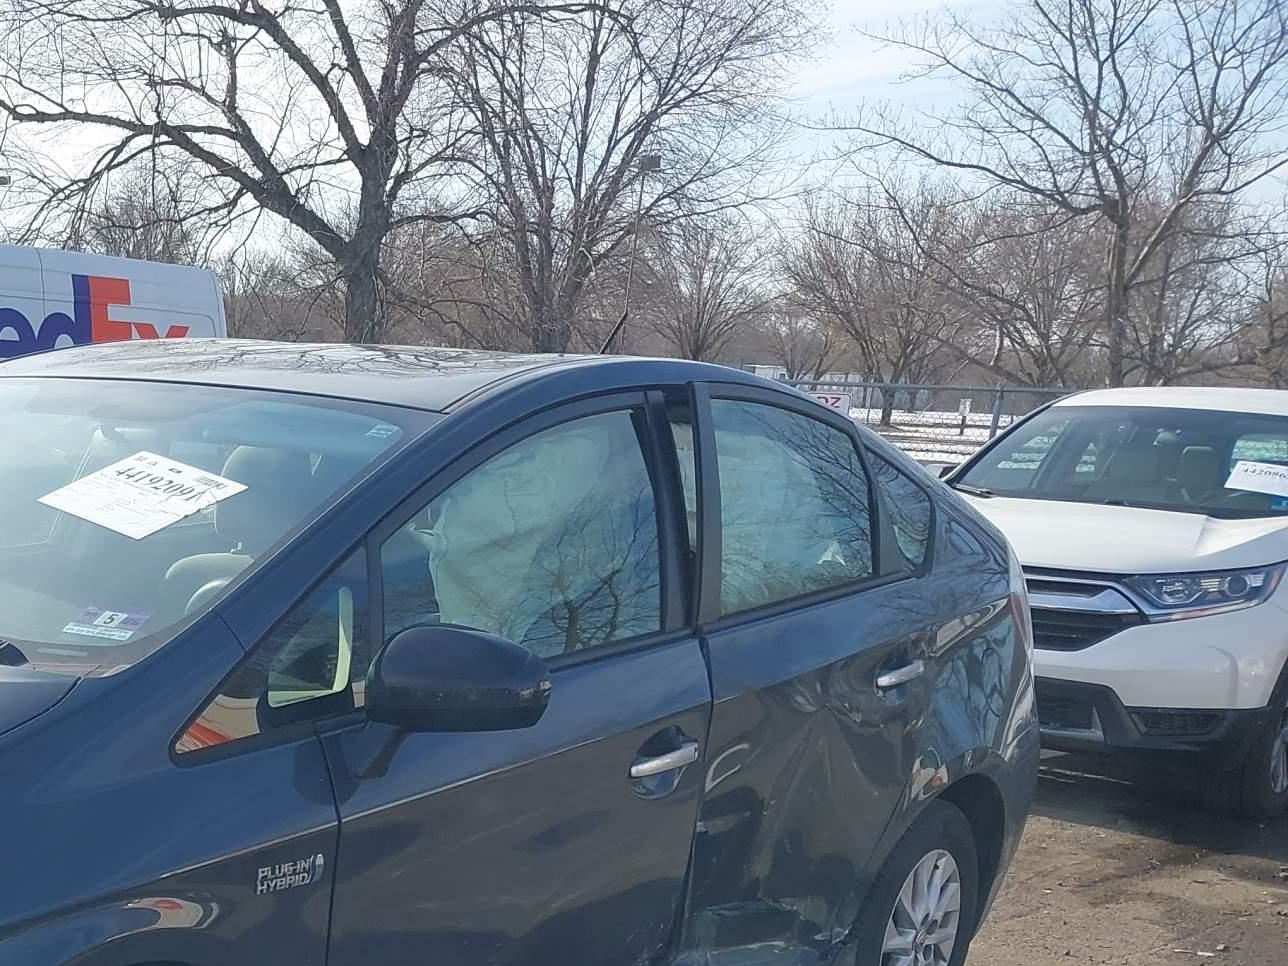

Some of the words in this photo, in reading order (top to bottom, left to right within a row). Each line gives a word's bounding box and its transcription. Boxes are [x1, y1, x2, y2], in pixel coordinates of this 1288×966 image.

[115, 466, 211, 502] 44192091
[103, 613, 119, 625] 5
[257, 859, 311, 881] PLUG-IN
[256, 873, 309, 895] HYBRID
